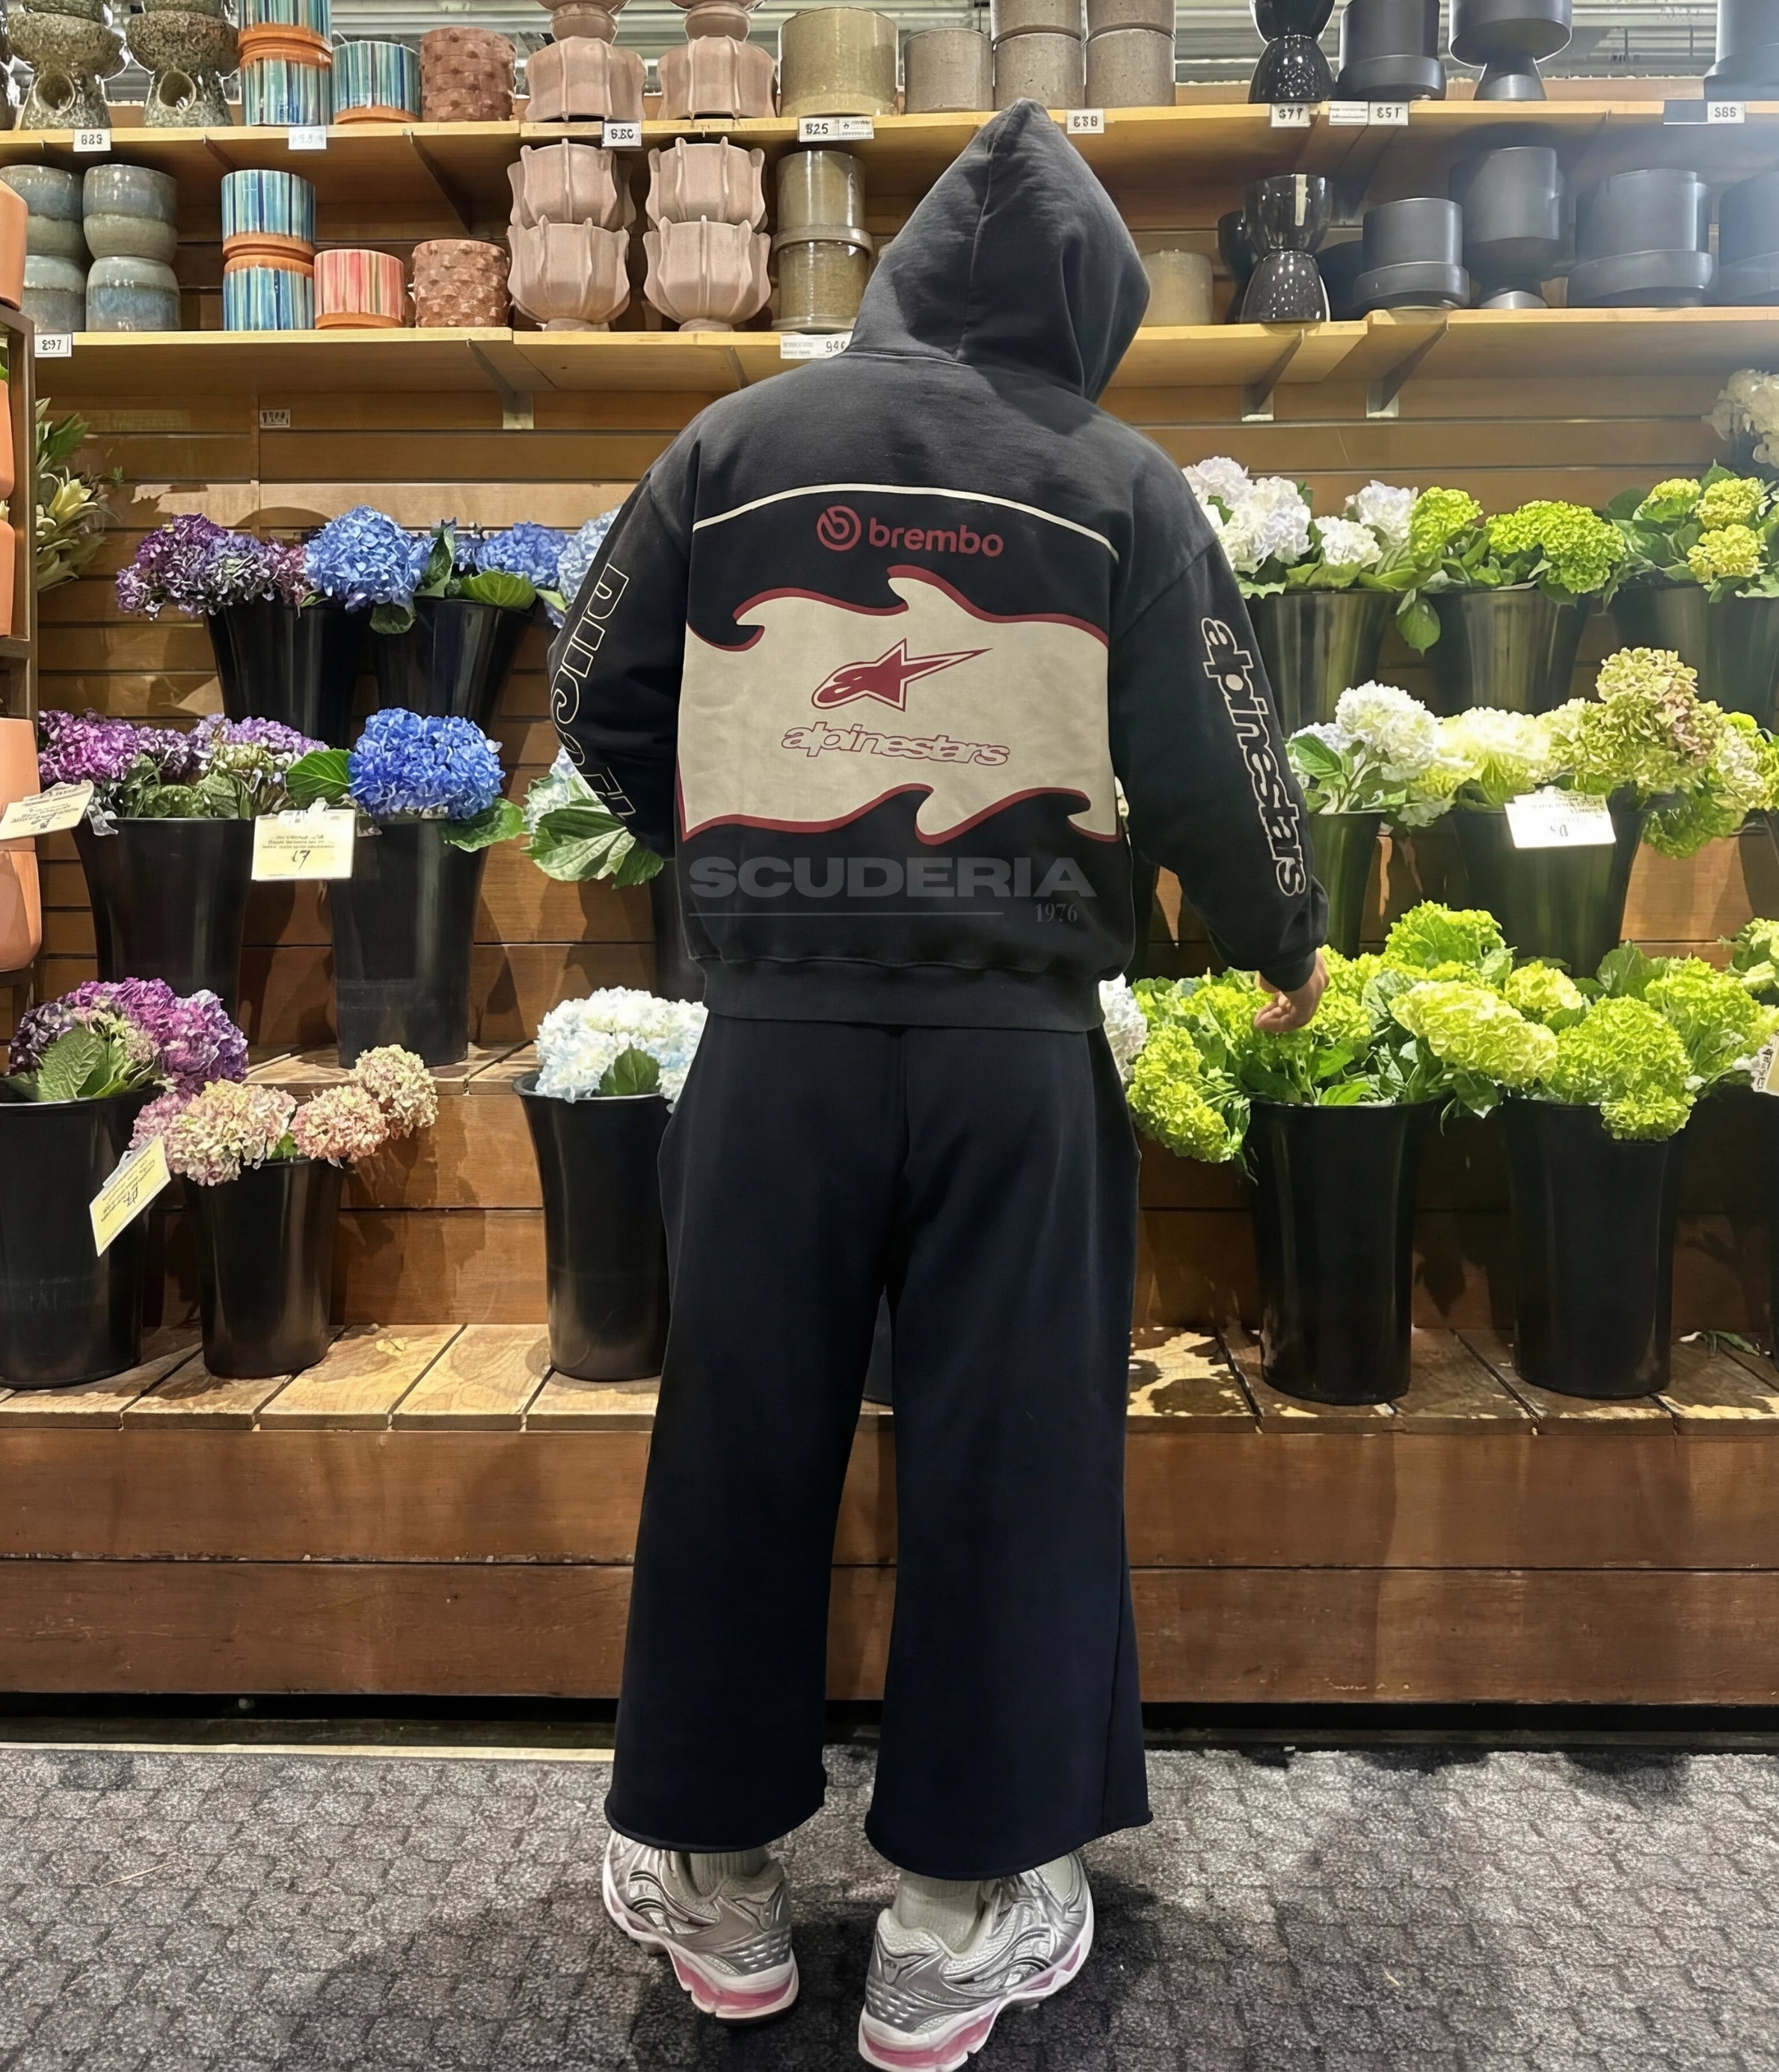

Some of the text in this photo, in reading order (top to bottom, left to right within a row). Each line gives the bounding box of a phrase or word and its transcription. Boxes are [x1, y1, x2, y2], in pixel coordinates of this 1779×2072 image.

[868, 517, 1004, 558] brembo
[781, 721, 1011, 766] alpinestars
[1199, 617, 1307, 897] alpinestars
